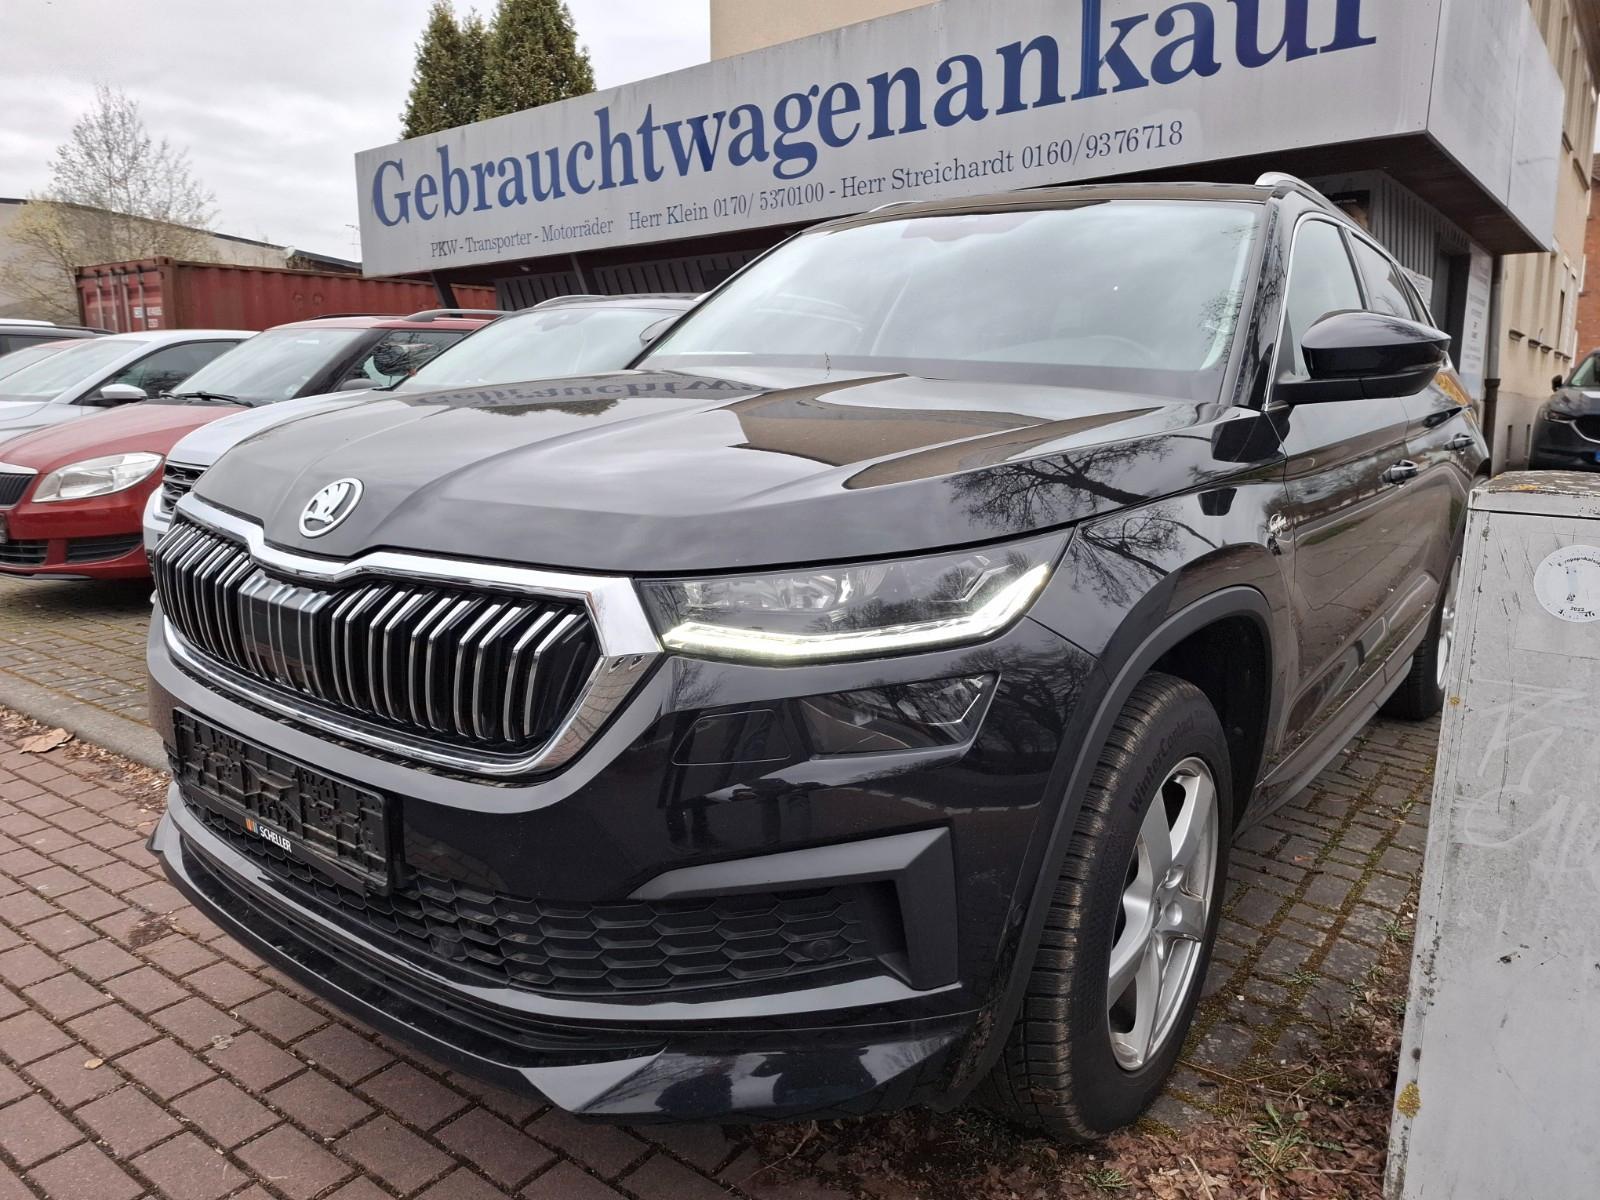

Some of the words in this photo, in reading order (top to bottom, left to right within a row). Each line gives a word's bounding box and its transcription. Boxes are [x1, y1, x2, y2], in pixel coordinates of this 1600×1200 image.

[629, 211, 662, 230] Herr
[666, 202, 708, 225] Klein
[760, 182, 824, 211] 5370100
[840, 175, 886, 199] Herr
[891, 150, 1015, 190] Streichardt
[1021, 120, 1184, 170] 0160/9376718
[541, 217, 614, 243] Motorräder
[259, 825, 292, 853] SCHELLER
